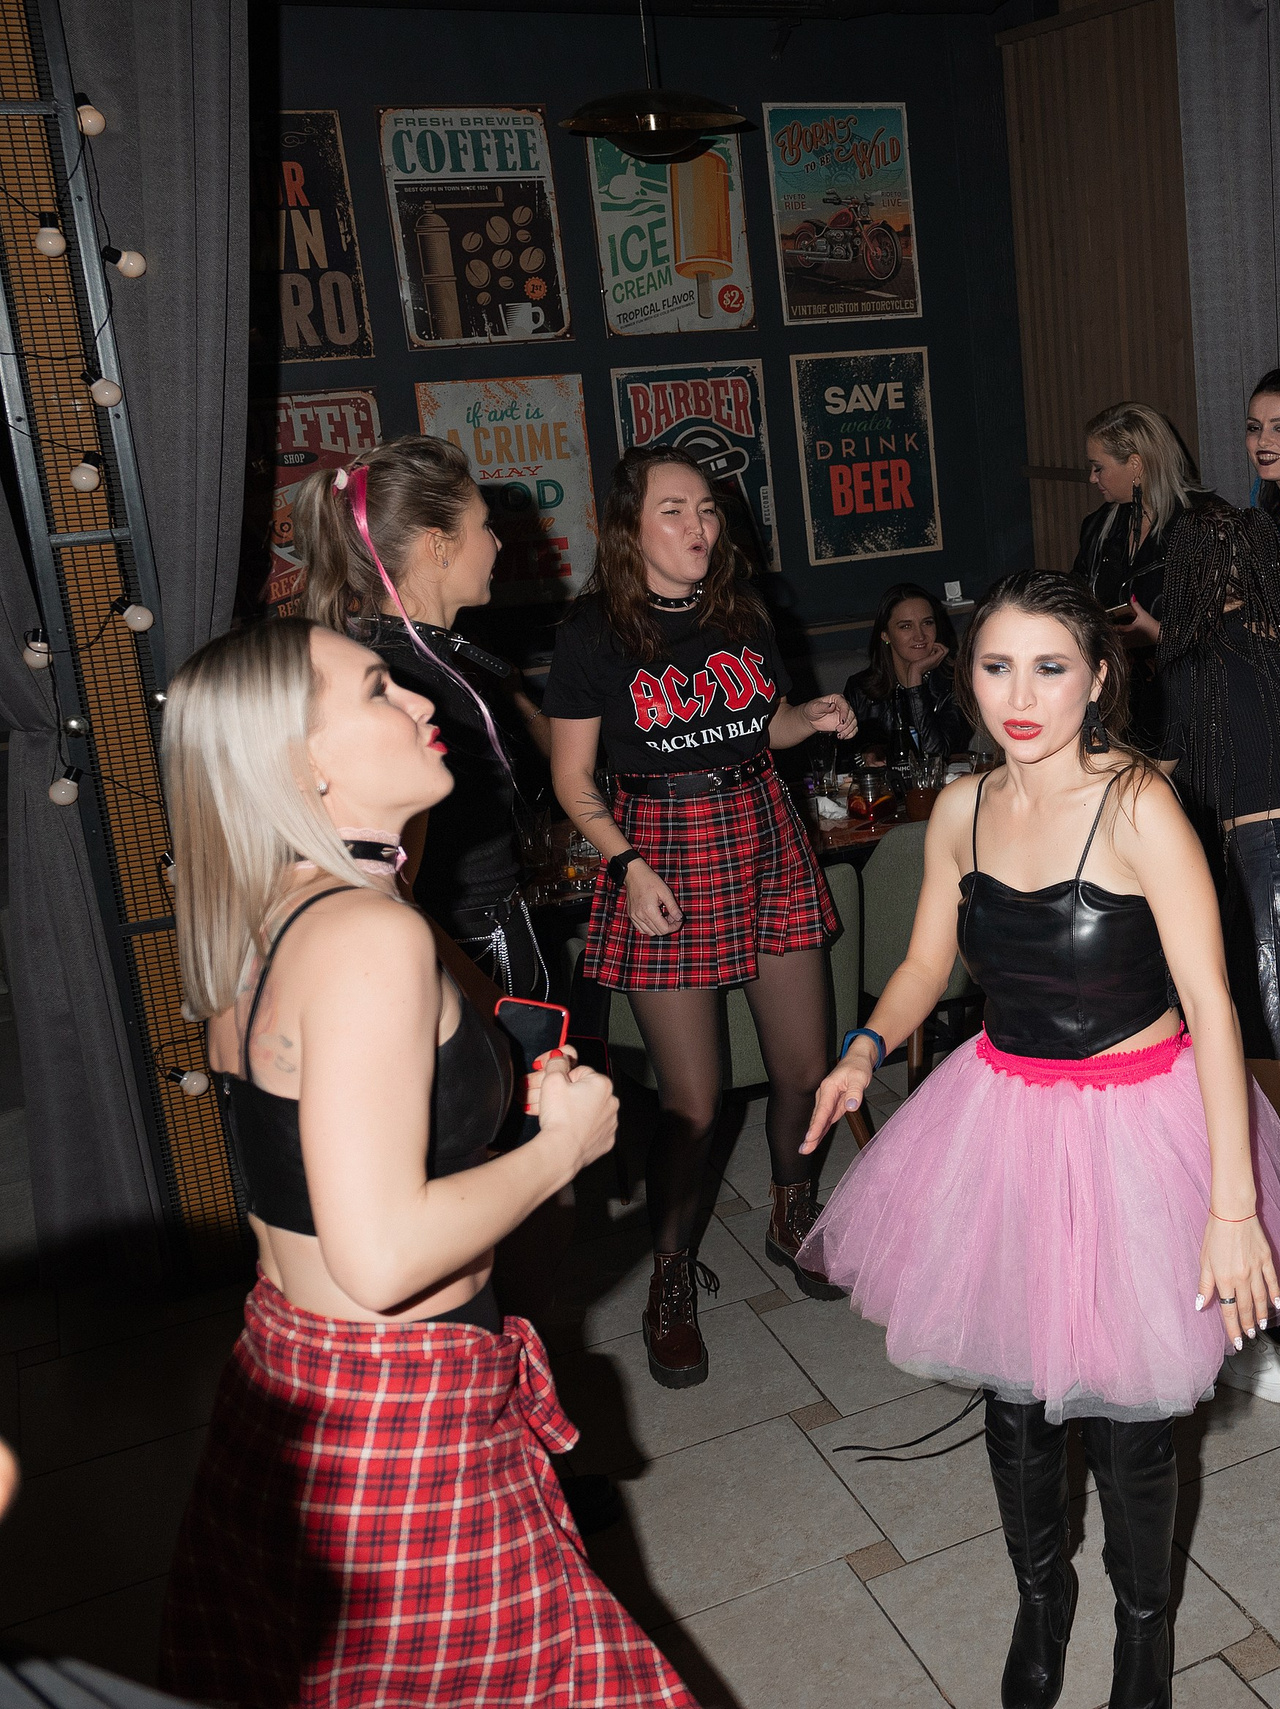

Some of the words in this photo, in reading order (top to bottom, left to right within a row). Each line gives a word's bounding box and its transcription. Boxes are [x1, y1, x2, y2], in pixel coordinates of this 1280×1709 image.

[393, 117, 453, 127] FRESH
[460, 116, 534, 126] BREWED
[392, 129, 540, 174] COFFEE
[804, 162, 816, 174] TO
[819, 154, 831, 167] BE
[784, 201, 807, 210] RIDE
[882, 198, 902, 208] LIVE
[607, 217, 670, 277] ICE
[612, 265, 673, 304] CREAM
[616, 302, 661, 324] TROPICAL
[661, 290, 695, 310] FLAVOR
[790, 303, 828, 316] VINTAGE
[828, 302, 859, 314] CUSTOM
[860, 299, 915, 312] MOTORCYCLES
[627, 376, 756, 446] BARBER
[824, 381, 906, 415] SAVE
[466, 402, 483, 429] if
[487, 400, 521, 421] art
[525, 402, 544, 420] is
[840, 413, 892, 434] water
[472, 421, 571, 466] CRIME
[816, 432, 920, 461] DRINK
[283, 453, 305, 465] SHOP
[478, 465, 543, 481] MAY
[828, 458, 915, 517] BEER
[700, 725, 724, 745] IN
